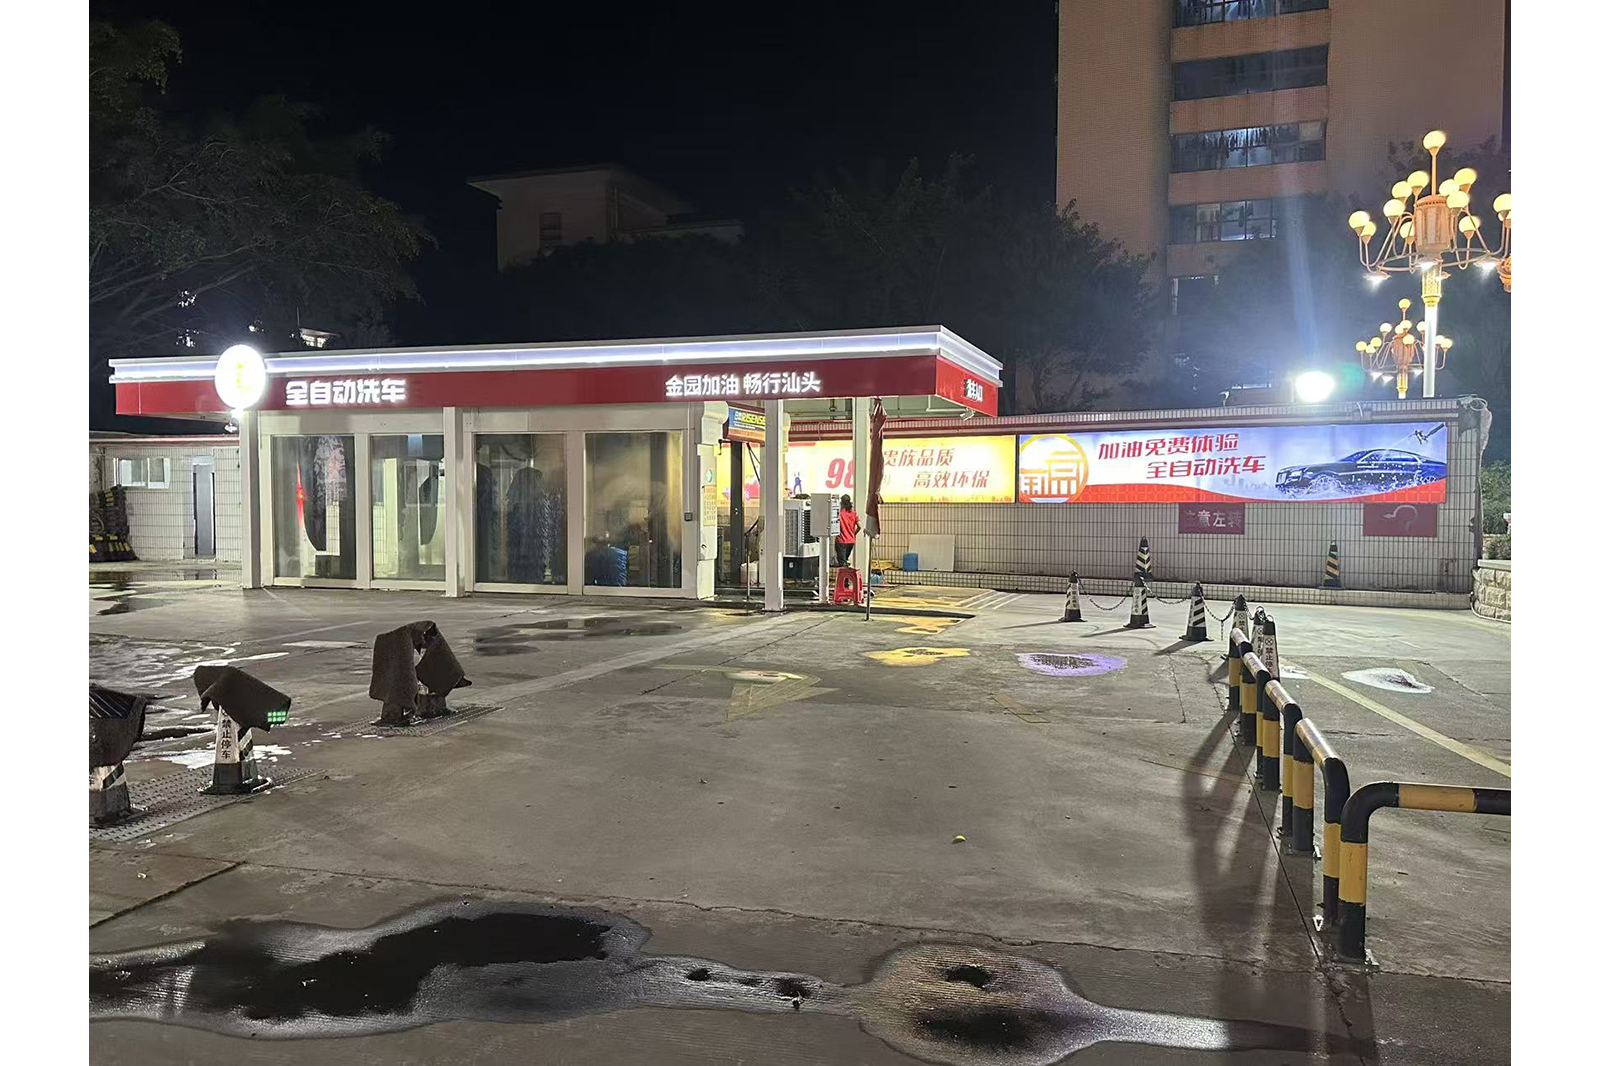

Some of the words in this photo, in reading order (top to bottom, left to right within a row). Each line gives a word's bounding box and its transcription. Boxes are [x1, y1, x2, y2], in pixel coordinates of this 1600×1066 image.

[285, 378, 407, 407] 全自动洗车
[664, 374, 739, 397] 金园加油
[743, 371, 821, 394] 畅行汕头
[1098, 433, 1240, 460] 加油免费体验
[913, 469, 990, 489] 高效环保
[1145, 455, 1267, 480] 全自动洗车
[221, 718, 232, 760] 禁止停车
